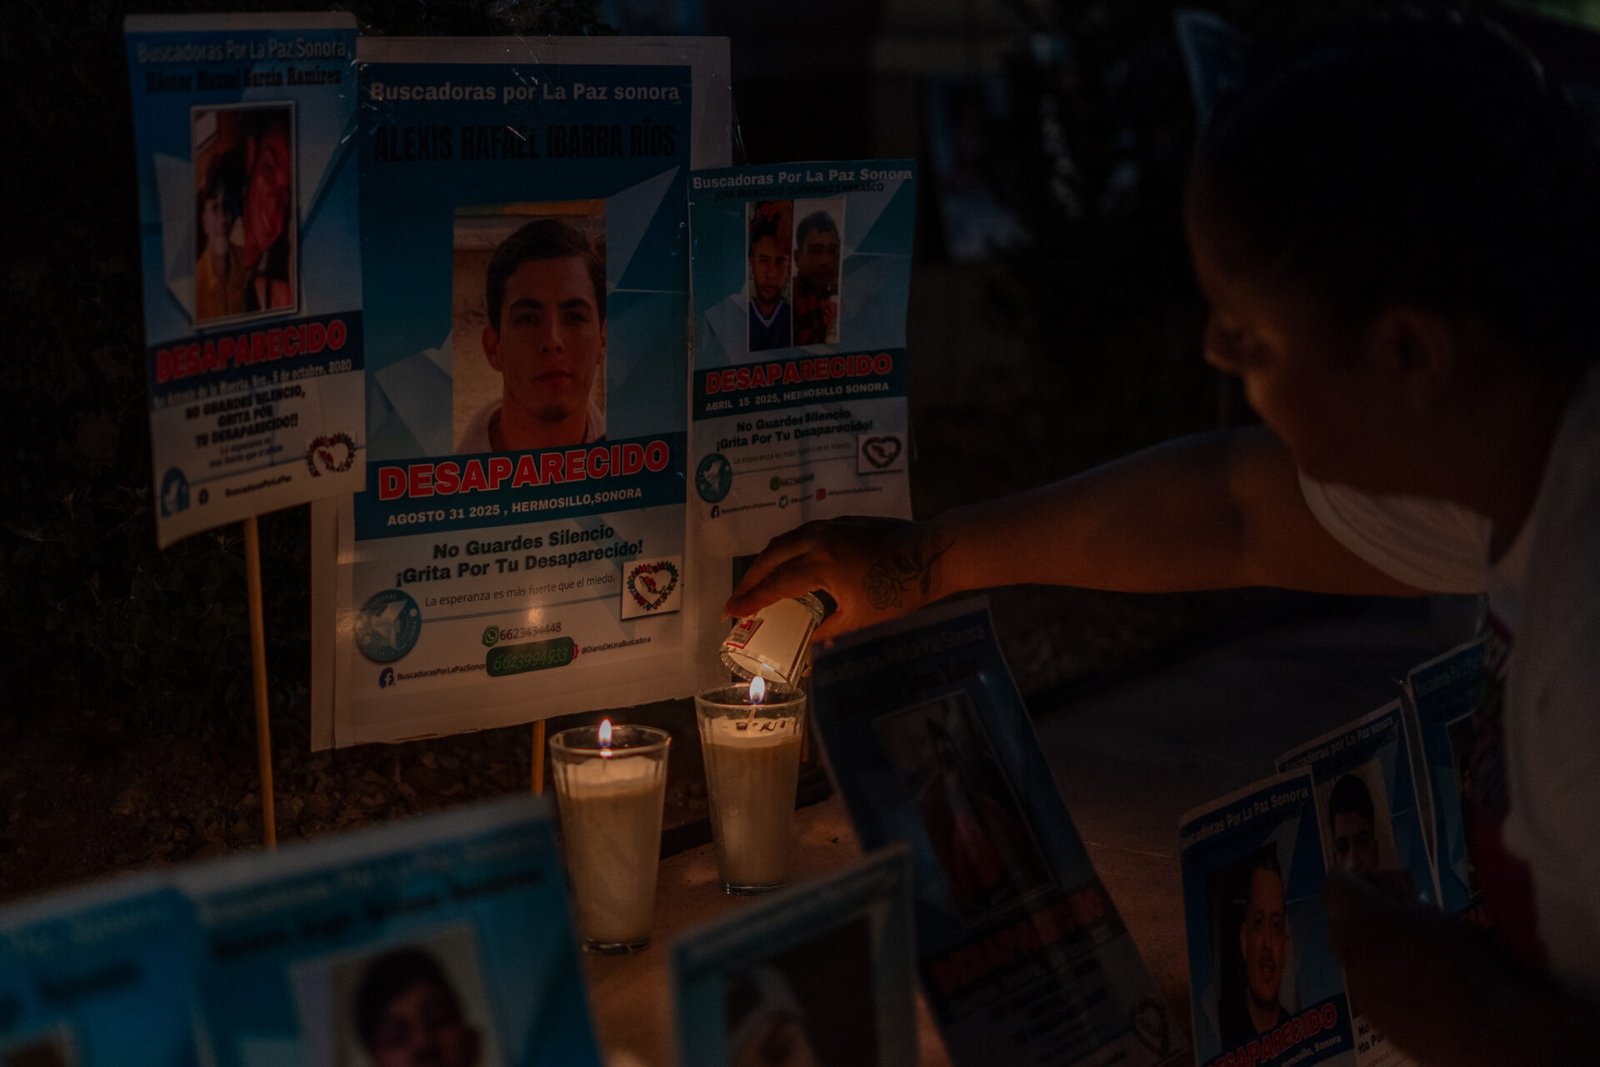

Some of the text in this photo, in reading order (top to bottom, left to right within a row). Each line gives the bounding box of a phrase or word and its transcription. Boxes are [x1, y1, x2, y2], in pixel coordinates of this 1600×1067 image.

[136, 37, 347, 64] Buscadoras Por La Paz Sonora
[370, 82, 681, 104] Buscadoras por La Paz sonora
[373, 116, 677, 161] ALEXIS RAFAEL IBARRA RÍOS
[692, 167, 913, 190] Buscadoras Por La Paz Sonora
[155, 320, 348, 385] DESAPARECIDO
[705, 352, 894, 396] DESAPARECIDO
[186, 406, 200, 420] NO
[204, 397, 254, 416] GUARDES
[704, 400, 734, 412] ABRIL
[783, 386, 843, 402] HERMOSILLO
[846, 381, 890, 394] SONORA
[218, 404, 274, 428] GRITA POR
[737, 409, 852, 433] No Guardes Silencio
[196, 434, 209, 448] TU
[752, 433, 773, 446] Por
[775, 431, 791, 442] Tu
[794, 419, 874, 441] Desaparecido!
[377, 439, 671, 502] DESAPARECIDO
[386, 509, 445, 527] AGOSTO
[449, 507, 465, 521] 31
[468, 504, 501, 519] 2025
[433, 524, 615, 560] No Guardes Silencio
[396, 539, 644, 589] ¡Grita Por Tu Desaparecido!
[425, 573, 616, 609] La esperanza es más fuerte que el miedo.
[397, 662, 487, 682] BuscadorasPorLaPazSonor
[1227, 811, 1242, 828] Por
[1242, 806, 1254, 822] La
[1253, 799, 1270, 817] Paz
[1270, 786, 1310, 809] Sonora
[1208, 1002, 1338, 1067] ESAPARECIDO
[1357, 1023, 1370, 1037] No
